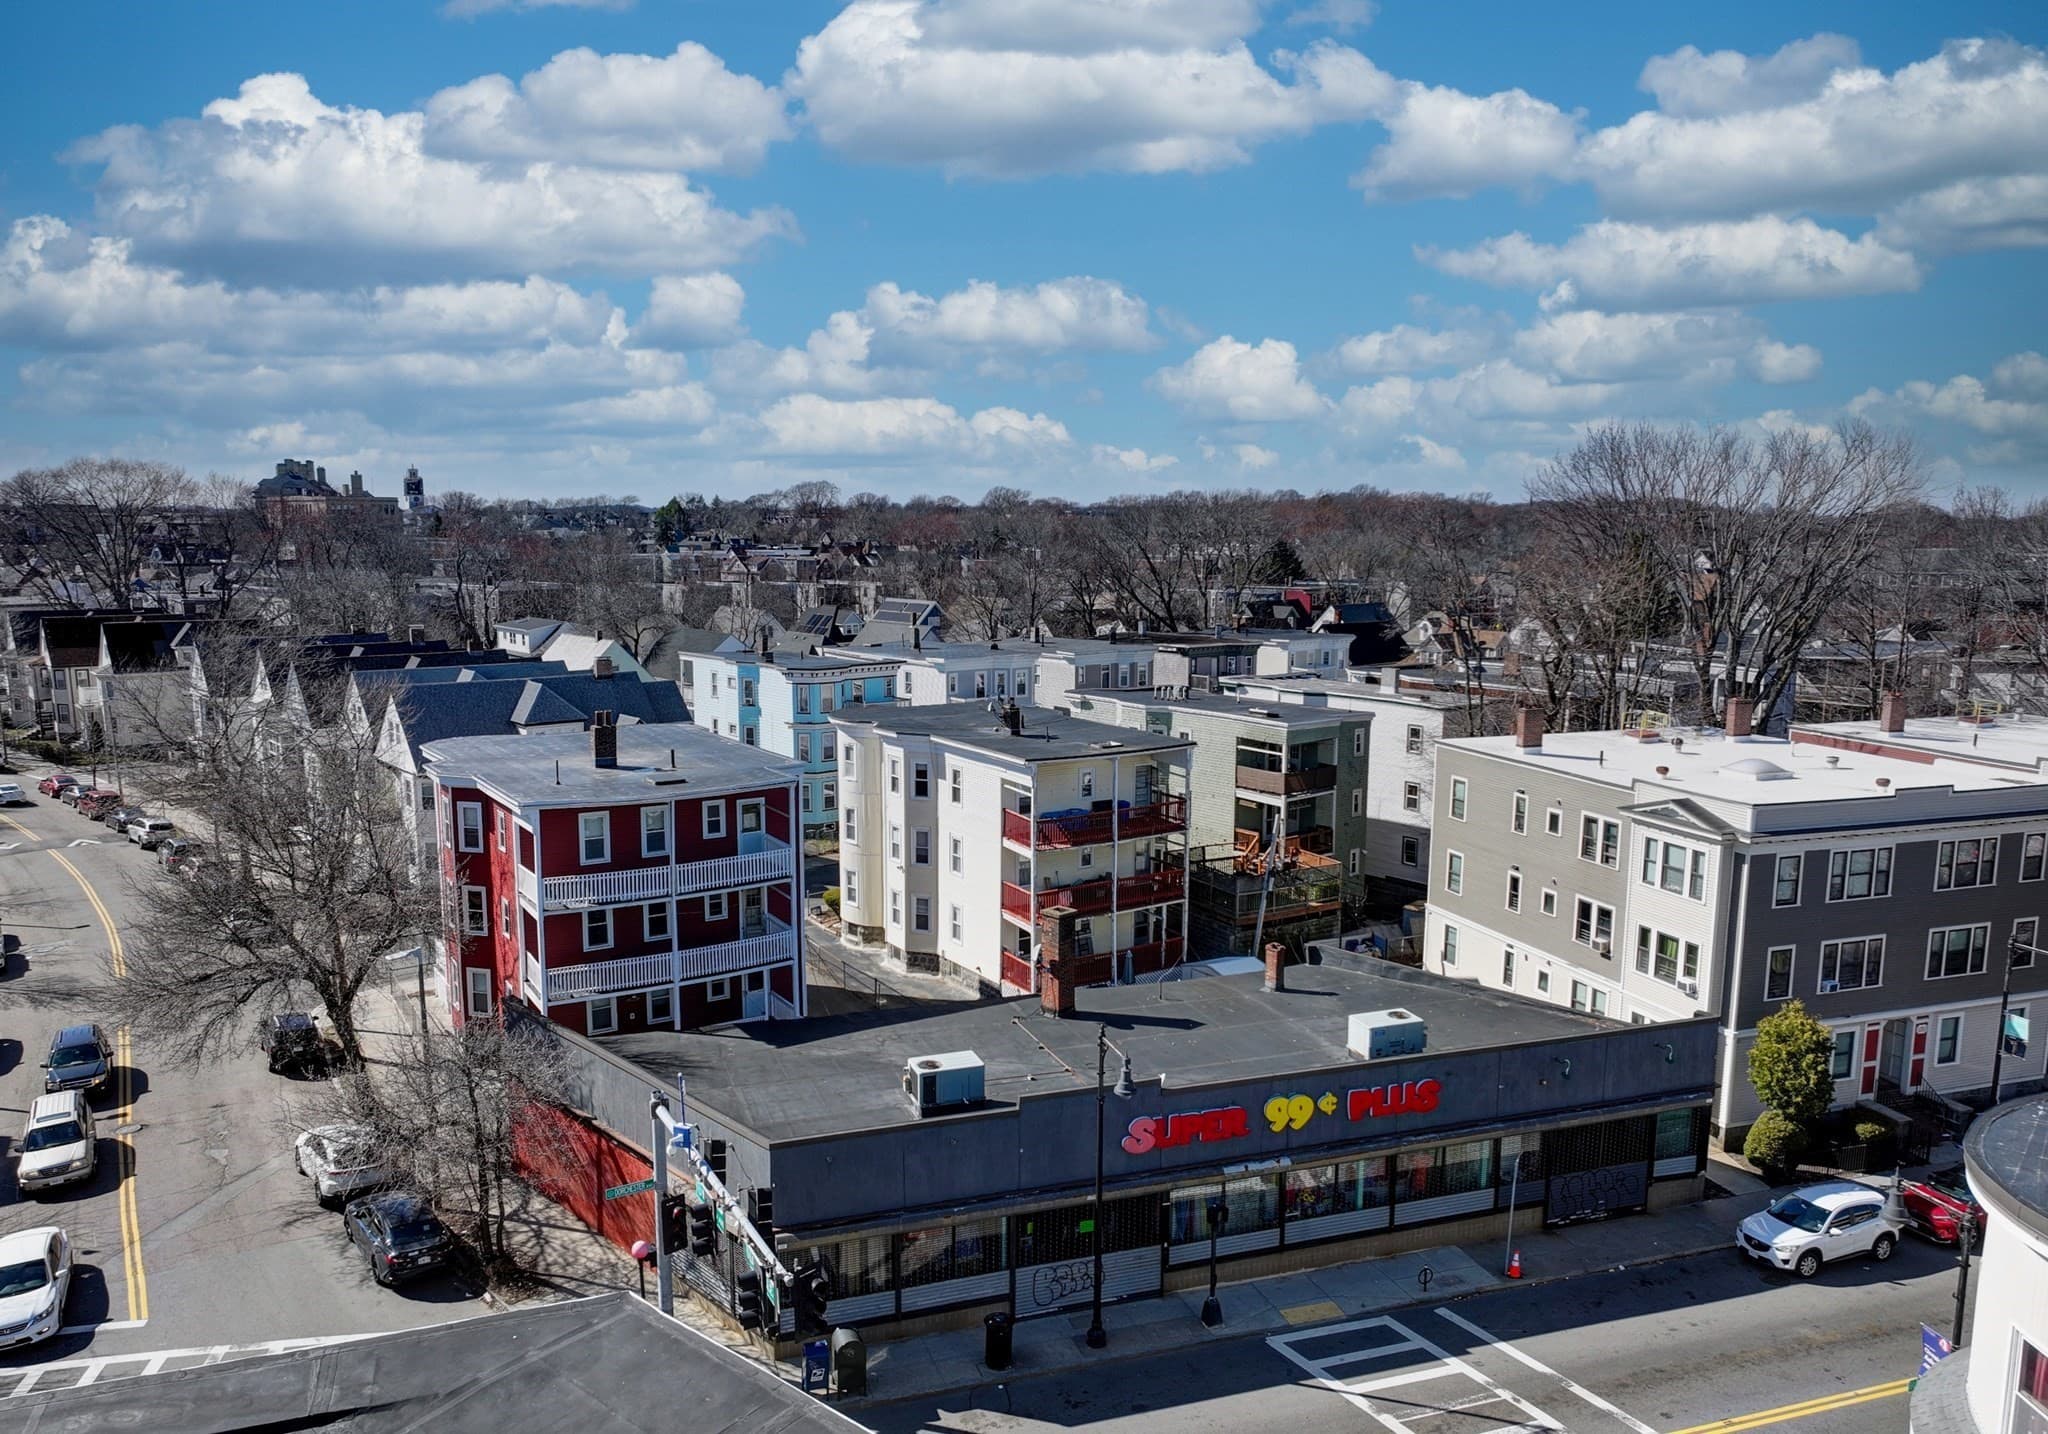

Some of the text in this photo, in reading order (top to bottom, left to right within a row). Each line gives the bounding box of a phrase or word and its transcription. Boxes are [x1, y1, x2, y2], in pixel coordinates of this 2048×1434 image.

[1121, 1105, 1250, 1155] SUPER
[1347, 1078, 1442, 1122] PLUS
[613, 1182, 646, 1197] DORCHESTER
